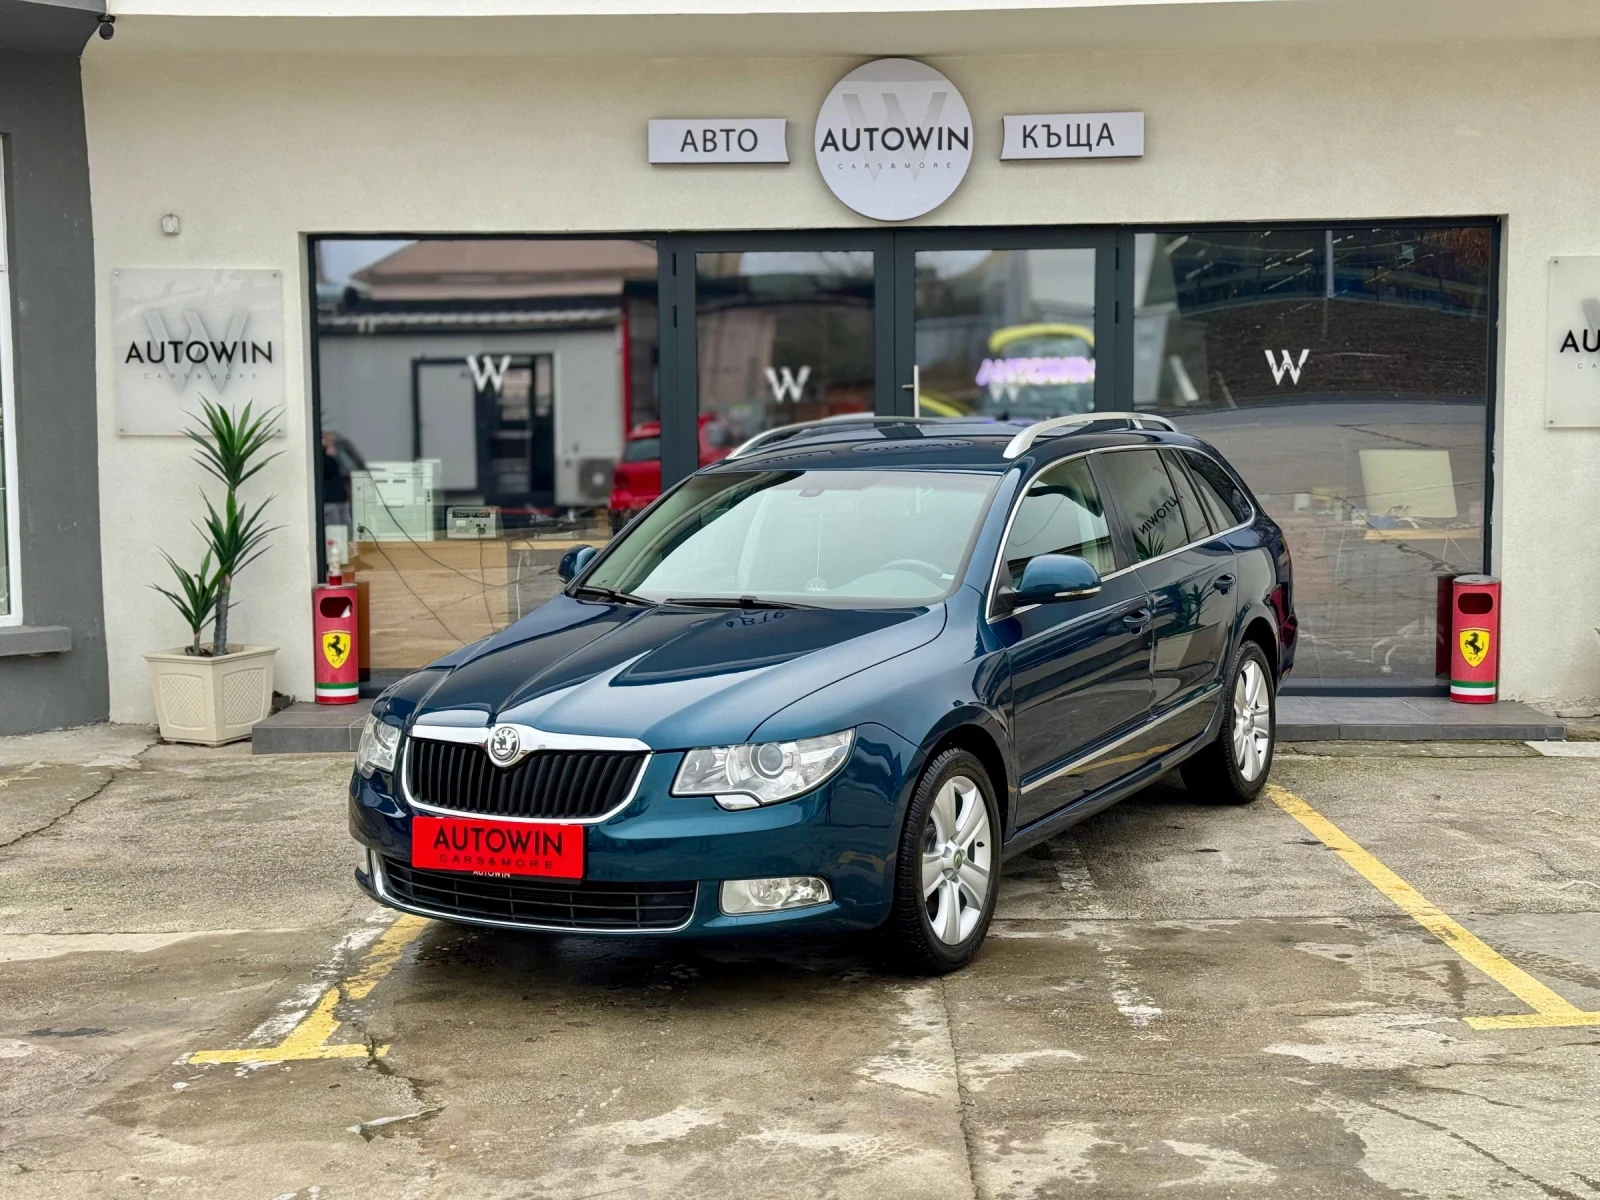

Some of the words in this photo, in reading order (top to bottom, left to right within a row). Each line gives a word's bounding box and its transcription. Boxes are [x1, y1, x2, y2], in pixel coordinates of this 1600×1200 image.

[680, 128, 758, 153] АВТО
[819, 126, 969, 153] AUTOWIN
[1022, 121, 1116, 152] КЪЩА
[837, 161, 952, 170] CARS&MORE
[124, 340, 273, 365] AUTOWIN
[1264, 348, 1310, 386] W
[467, 354, 512, 392] W
[764, 364, 812, 404] W
[432, 825, 564, 858] AUTOWIN
[438, 853, 554, 870] CARS&MORE
